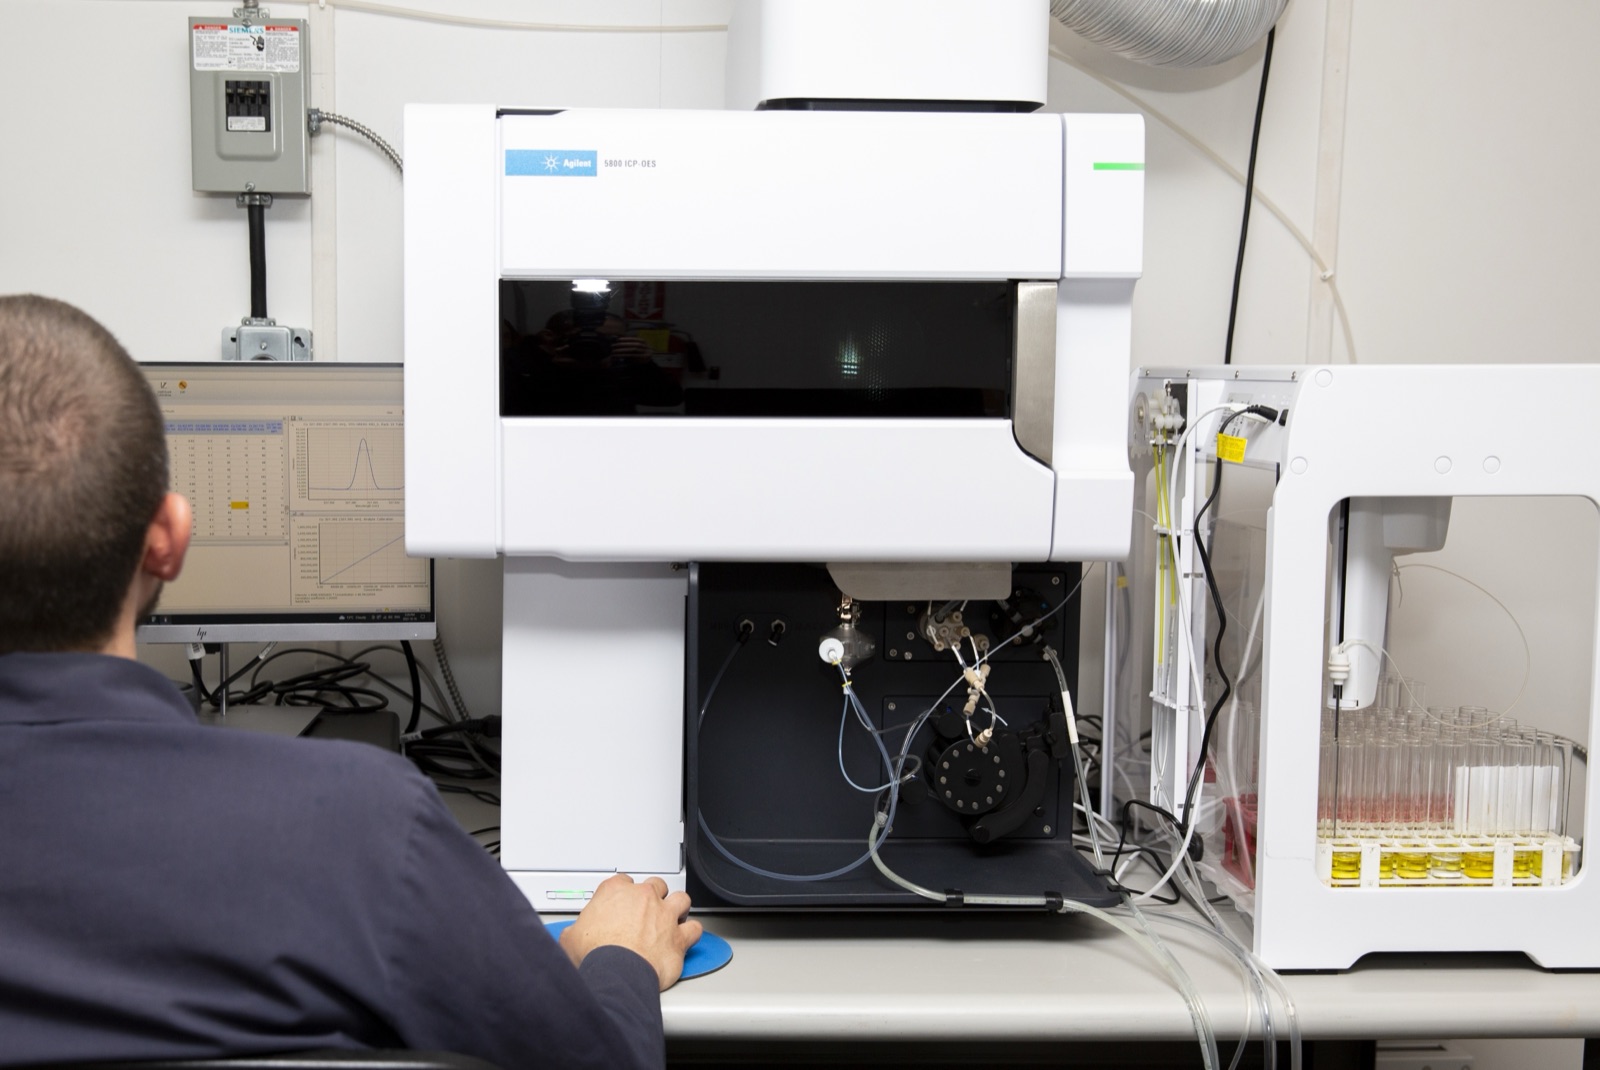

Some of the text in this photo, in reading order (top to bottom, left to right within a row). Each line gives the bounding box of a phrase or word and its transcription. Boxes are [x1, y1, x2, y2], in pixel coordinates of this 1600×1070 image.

[228, 26, 264, 34] SIEMENS
[563, 159, 592, 169] Agilent
[604, 159, 657, 168] 5800 ICP-OES
[196, 626, 208, 640] hp
